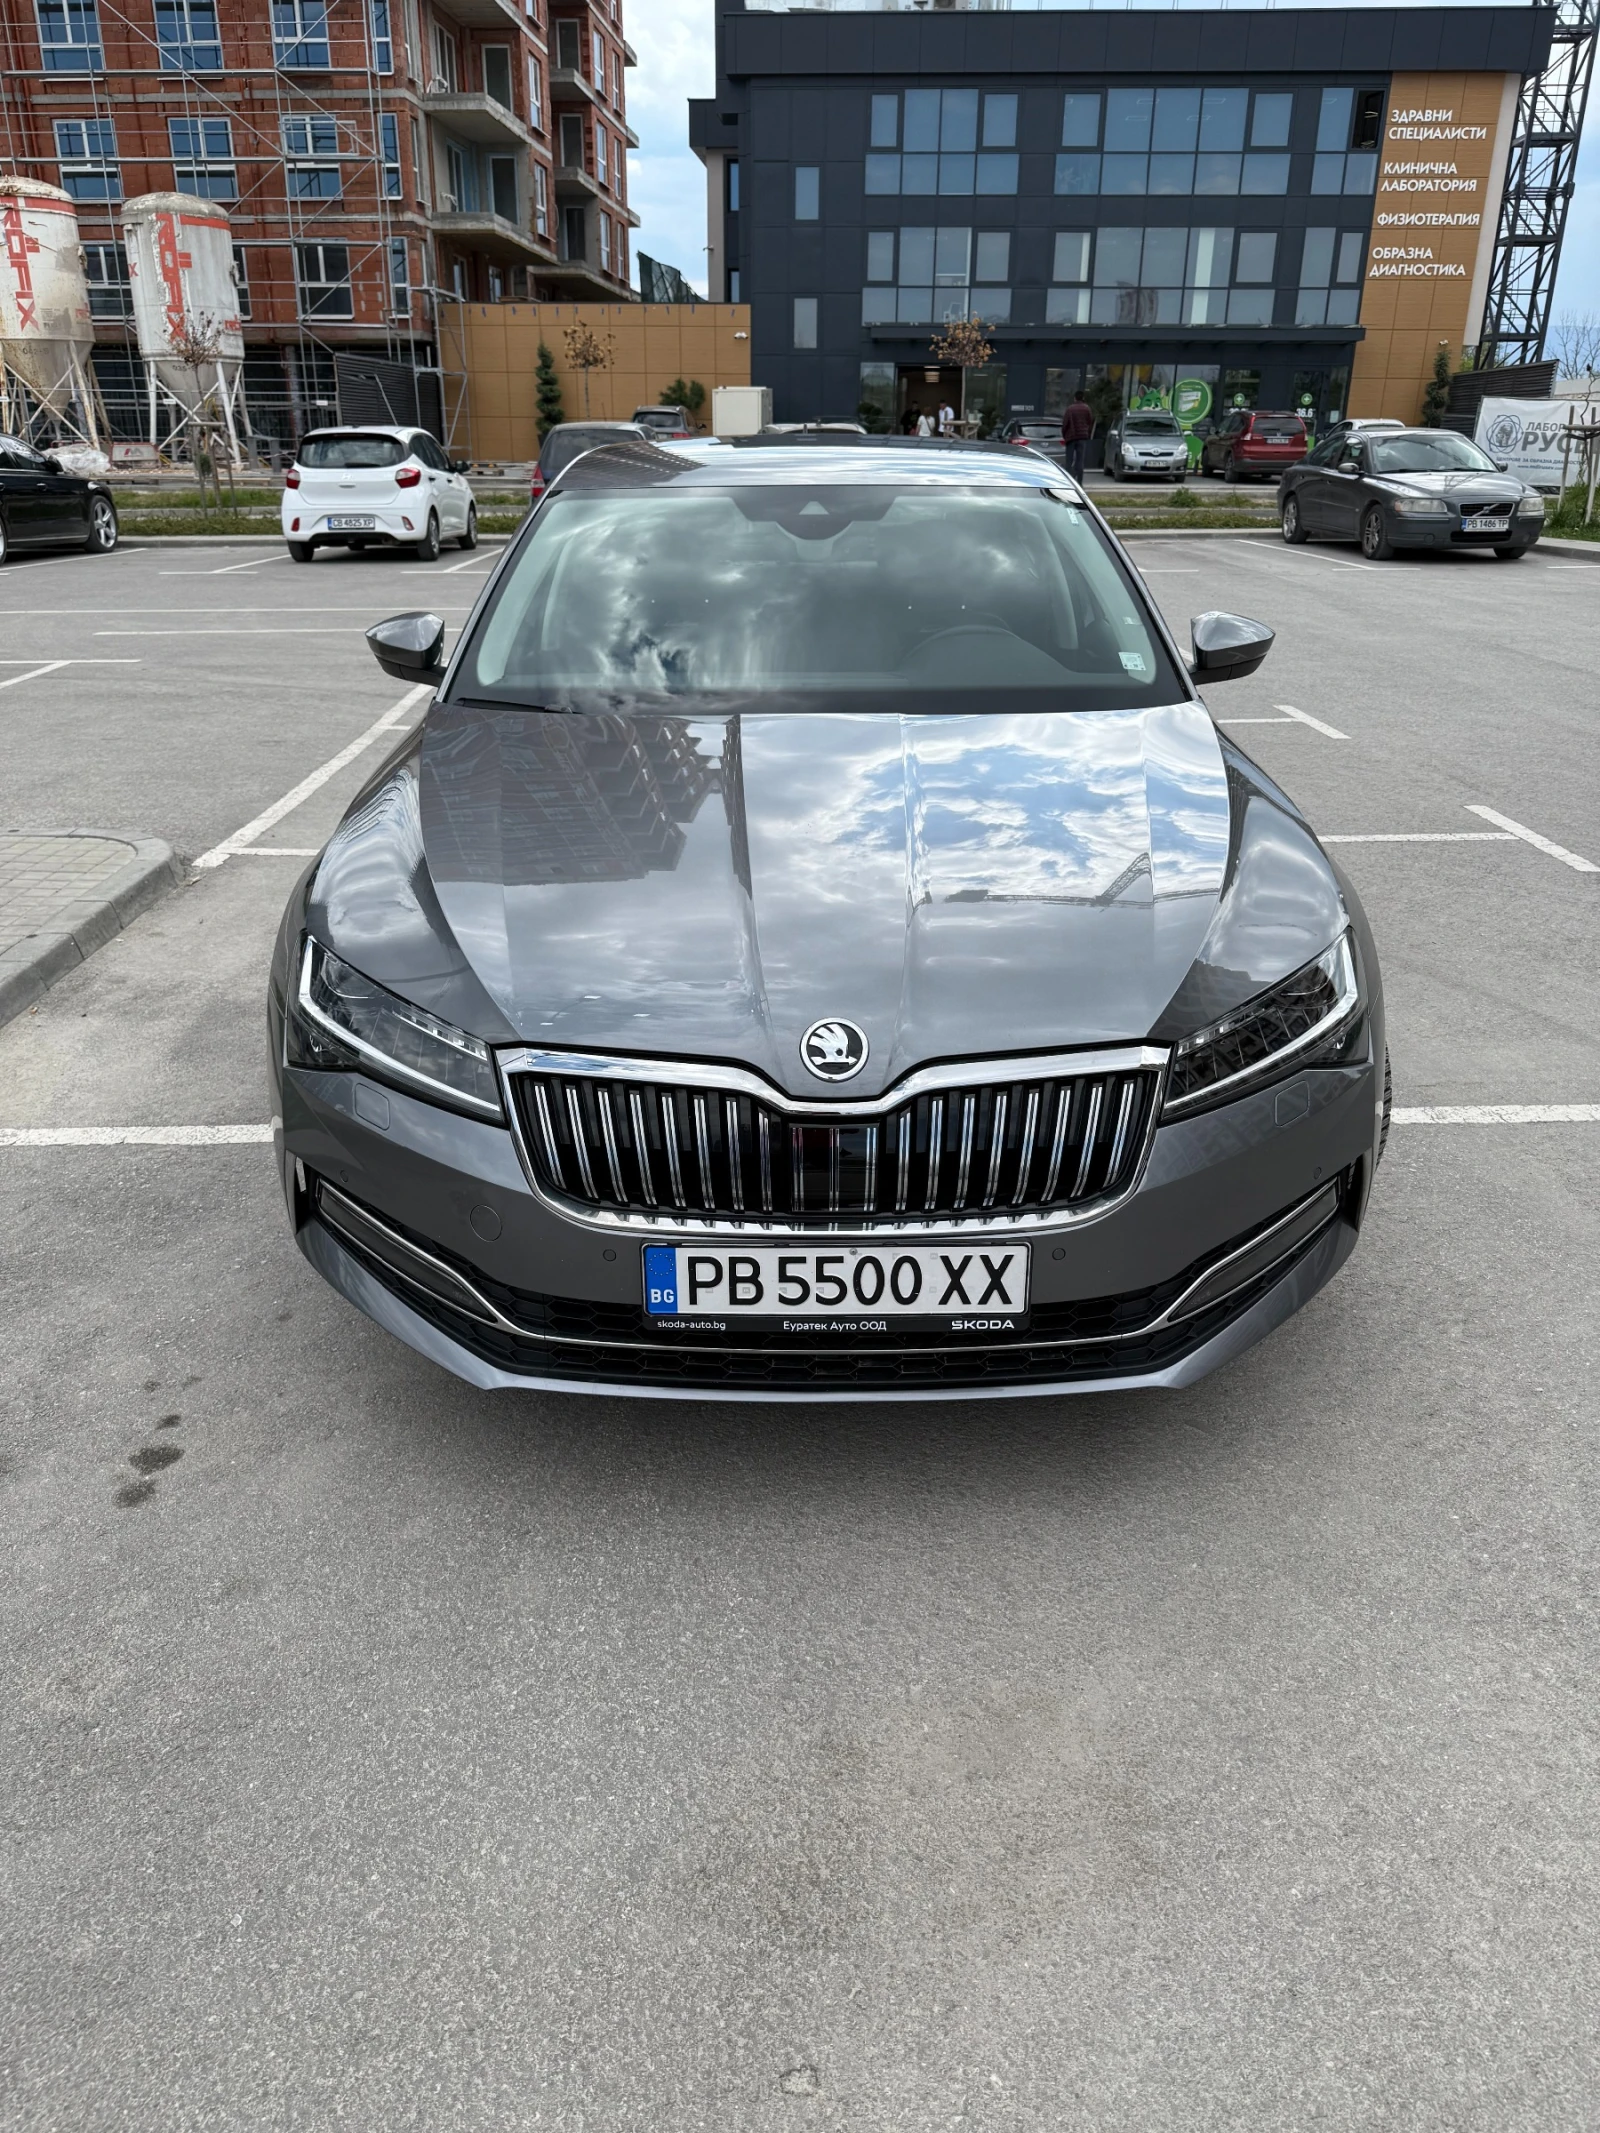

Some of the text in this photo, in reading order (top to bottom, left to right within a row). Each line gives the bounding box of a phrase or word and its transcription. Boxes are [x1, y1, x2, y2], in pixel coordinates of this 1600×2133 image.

[1391, 109, 1453, 123] ЗДРАВНИ
[1388, 127, 1487, 141] СПЕЦИАЛИСТИ
[1383, 162, 1458, 175] КЛИНИЧНА
[1381, 179, 1478, 192] ЛАБОРАТОРИЯ
[1377, 213, 1481, 226] ФИЗИОТЕРАПИЯ
[1372, 247, 1434, 260] ОБРАЗНА
[1369, 264, 1466, 277] ДИАГНОСТИКА
[687, 1254, 1014, 1306] PB 5500 XX
[650, 1288, 675, 1303] BG
[657, 1320, 726, 1331] skoda-auto.bg
[783, 1321, 887, 1332] Еуратек Ауто ООД
[951, 1320, 1015, 1330] SKODA
